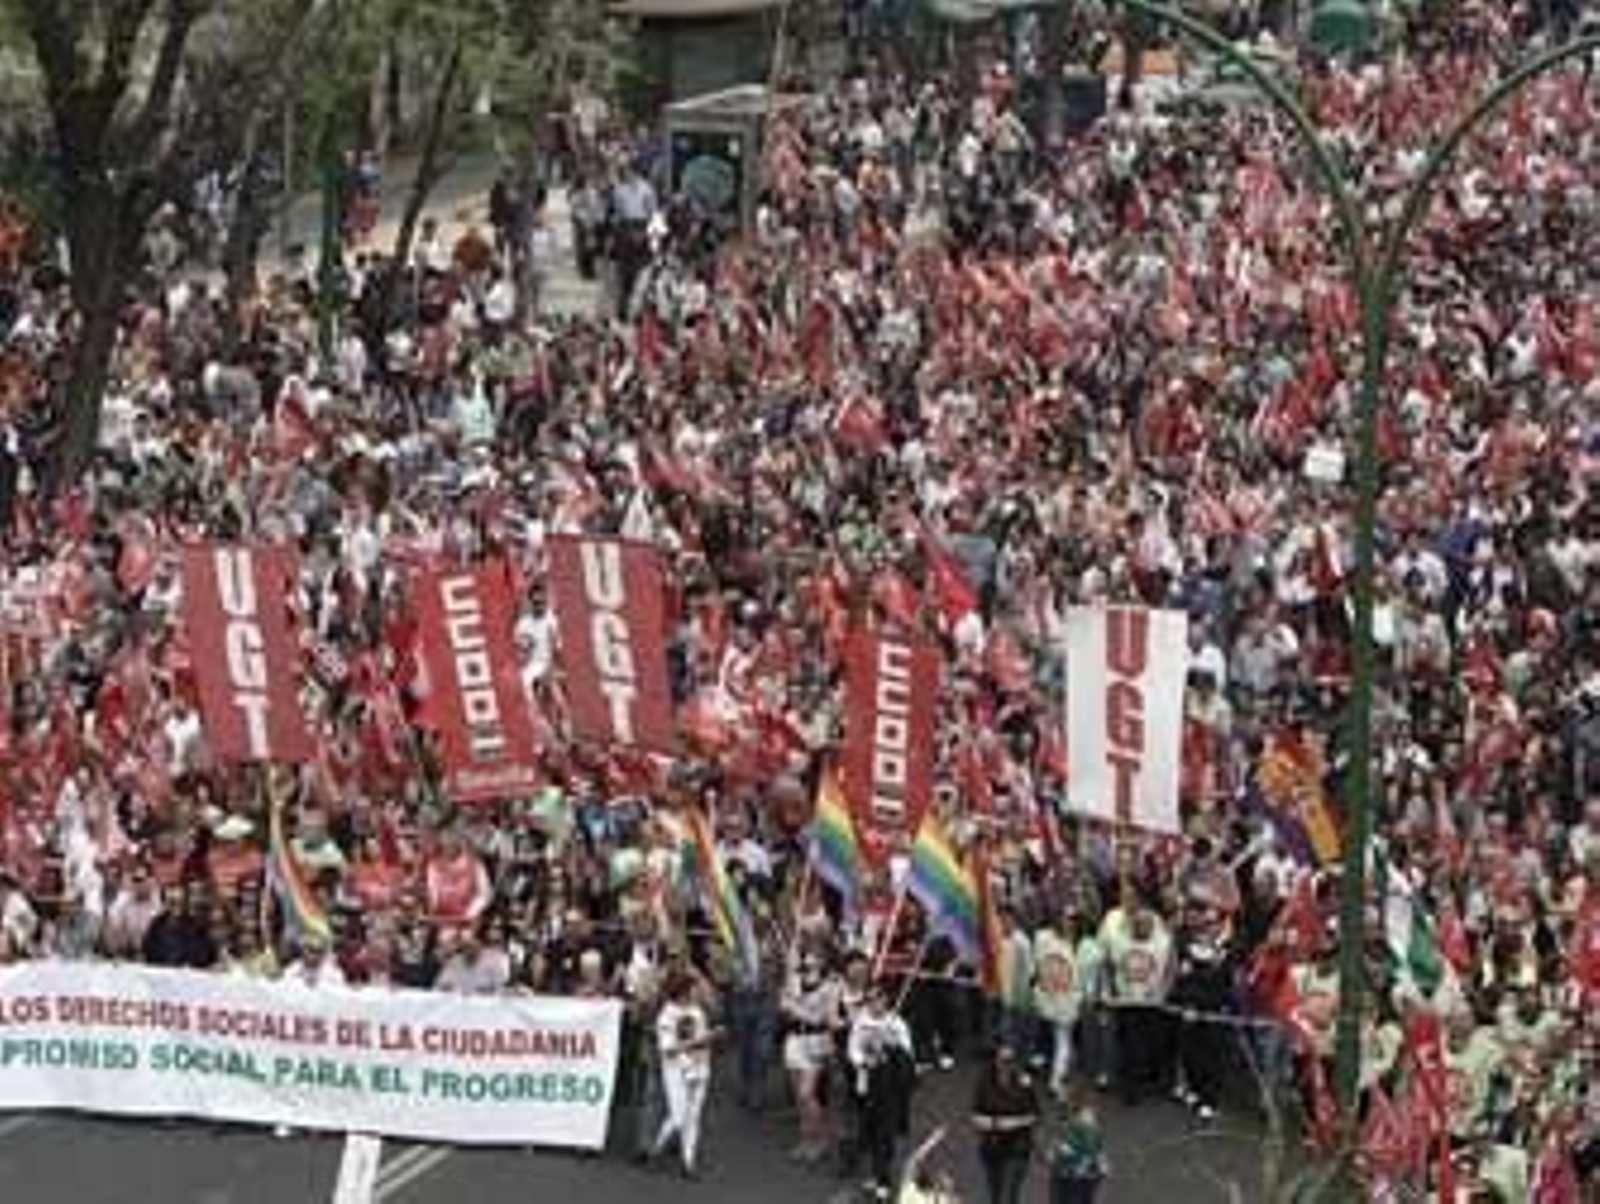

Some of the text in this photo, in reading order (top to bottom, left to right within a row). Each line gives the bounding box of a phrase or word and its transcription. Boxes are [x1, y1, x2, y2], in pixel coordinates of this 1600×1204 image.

[214, 548, 269, 760] UGT
[577, 541, 636, 743] UGT
[1106, 609, 1147, 823] UGT
[0, 997, 49, 1024] LOS
[57, 996, 190, 1031] DERECHOS
[199, 1007, 328, 1044] SOCIALES
[337, 1020, 371, 1049] DE
[380, 1025, 415, 1051] LA
[150, 1043, 267, 1083] SOCIAL
[274, 1056, 362, 1089] PARA
[371, 1065, 410, 1093] EL
[422, 1069, 605, 1104] PROGRESO
